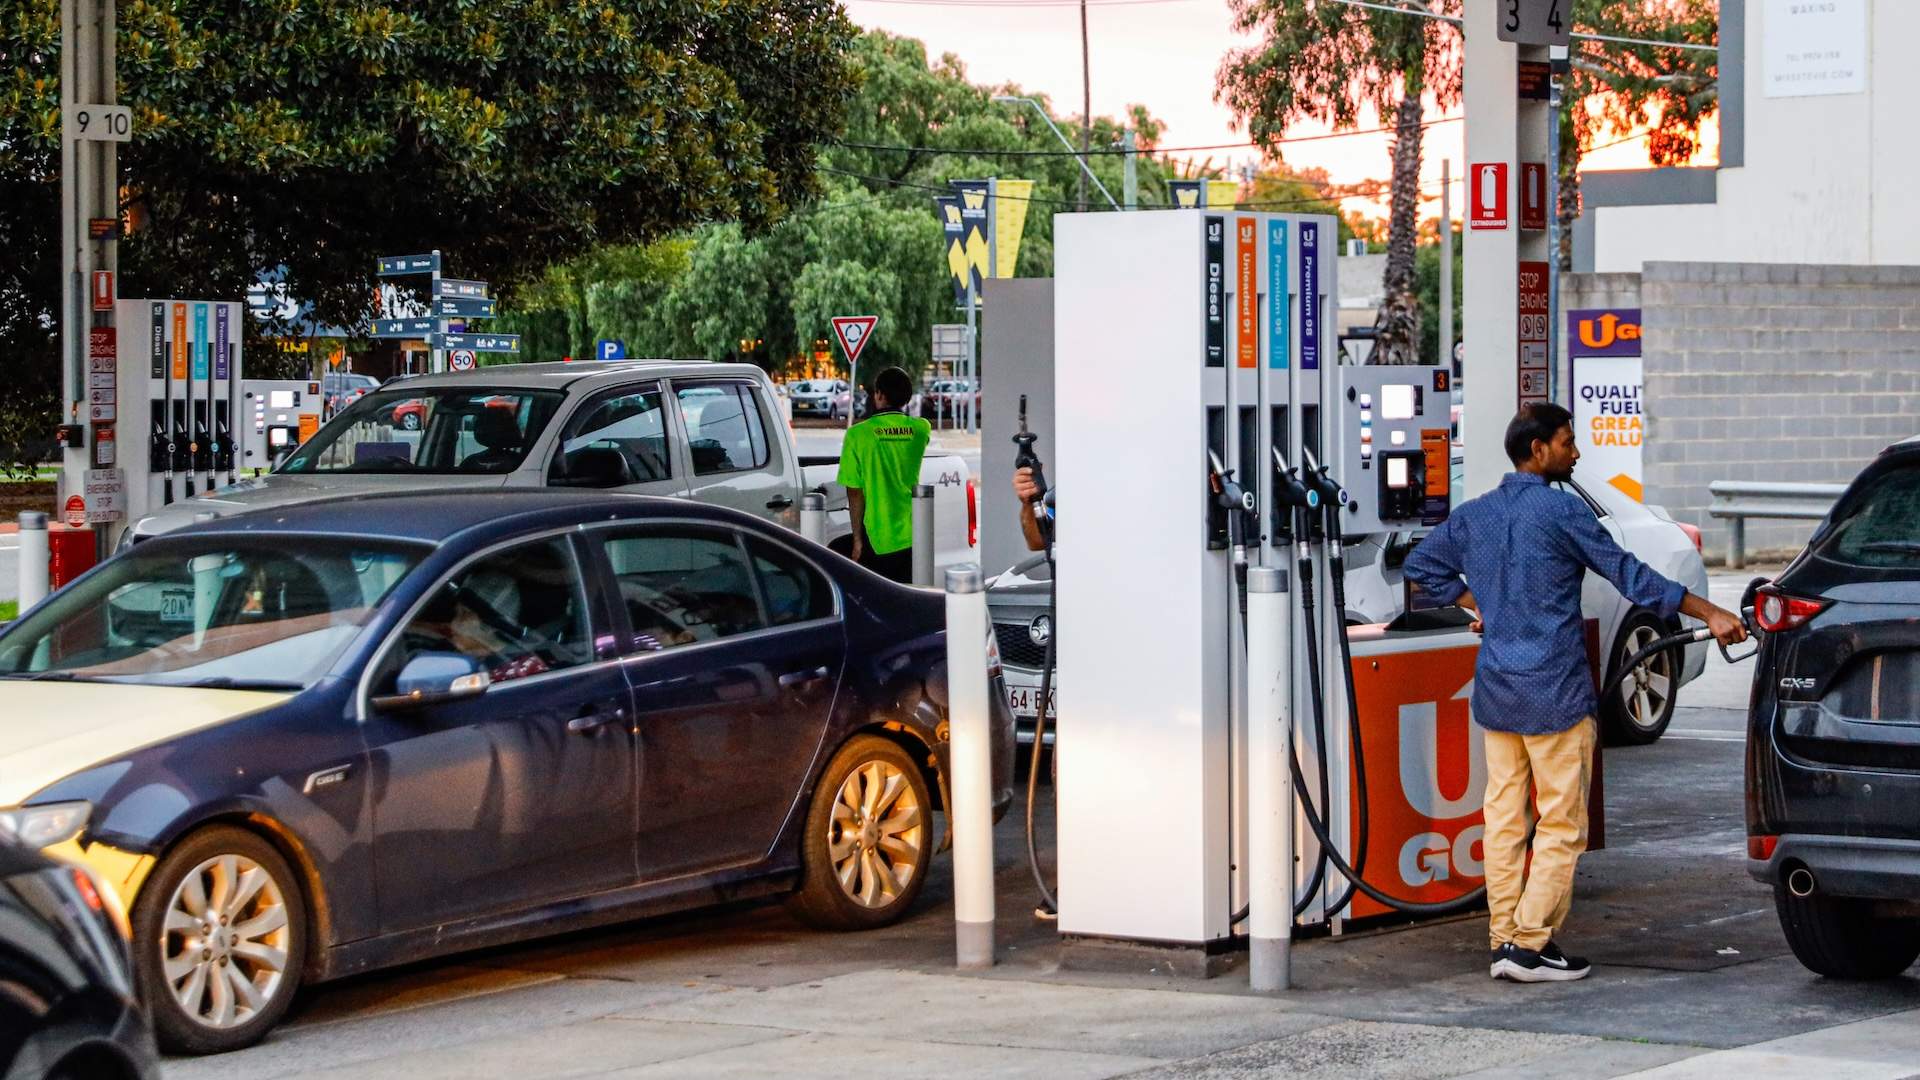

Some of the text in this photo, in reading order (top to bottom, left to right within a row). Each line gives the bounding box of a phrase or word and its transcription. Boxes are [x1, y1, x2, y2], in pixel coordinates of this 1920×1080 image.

[1505, 0, 1562, 34] 3 4
[77, 111, 129, 136] 9 10
[1243, 252, 1251, 315] Unleaded
[1304, 256, 1313, 316] Premium
[1520, 272, 1540, 289] STOP
[1209, 262, 1220, 321] Diesel
[1520, 292, 1548, 309] ENGINE
[1305, 319, 1313, 336] 98
[1579, 313, 1643, 348] UG
[90, 334, 108, 343] STOP
[90, 345, 116, 354] ENGINE
[604, 342, 618, 359] P
[454, 355, 471, 365] 50
[884, 427, 914, 436] YAMAHA
[938, 471, 961, 487] 4x4
[97, 497, 112, 507] STOP
[1780, 677, 1817, 688] CX-5
